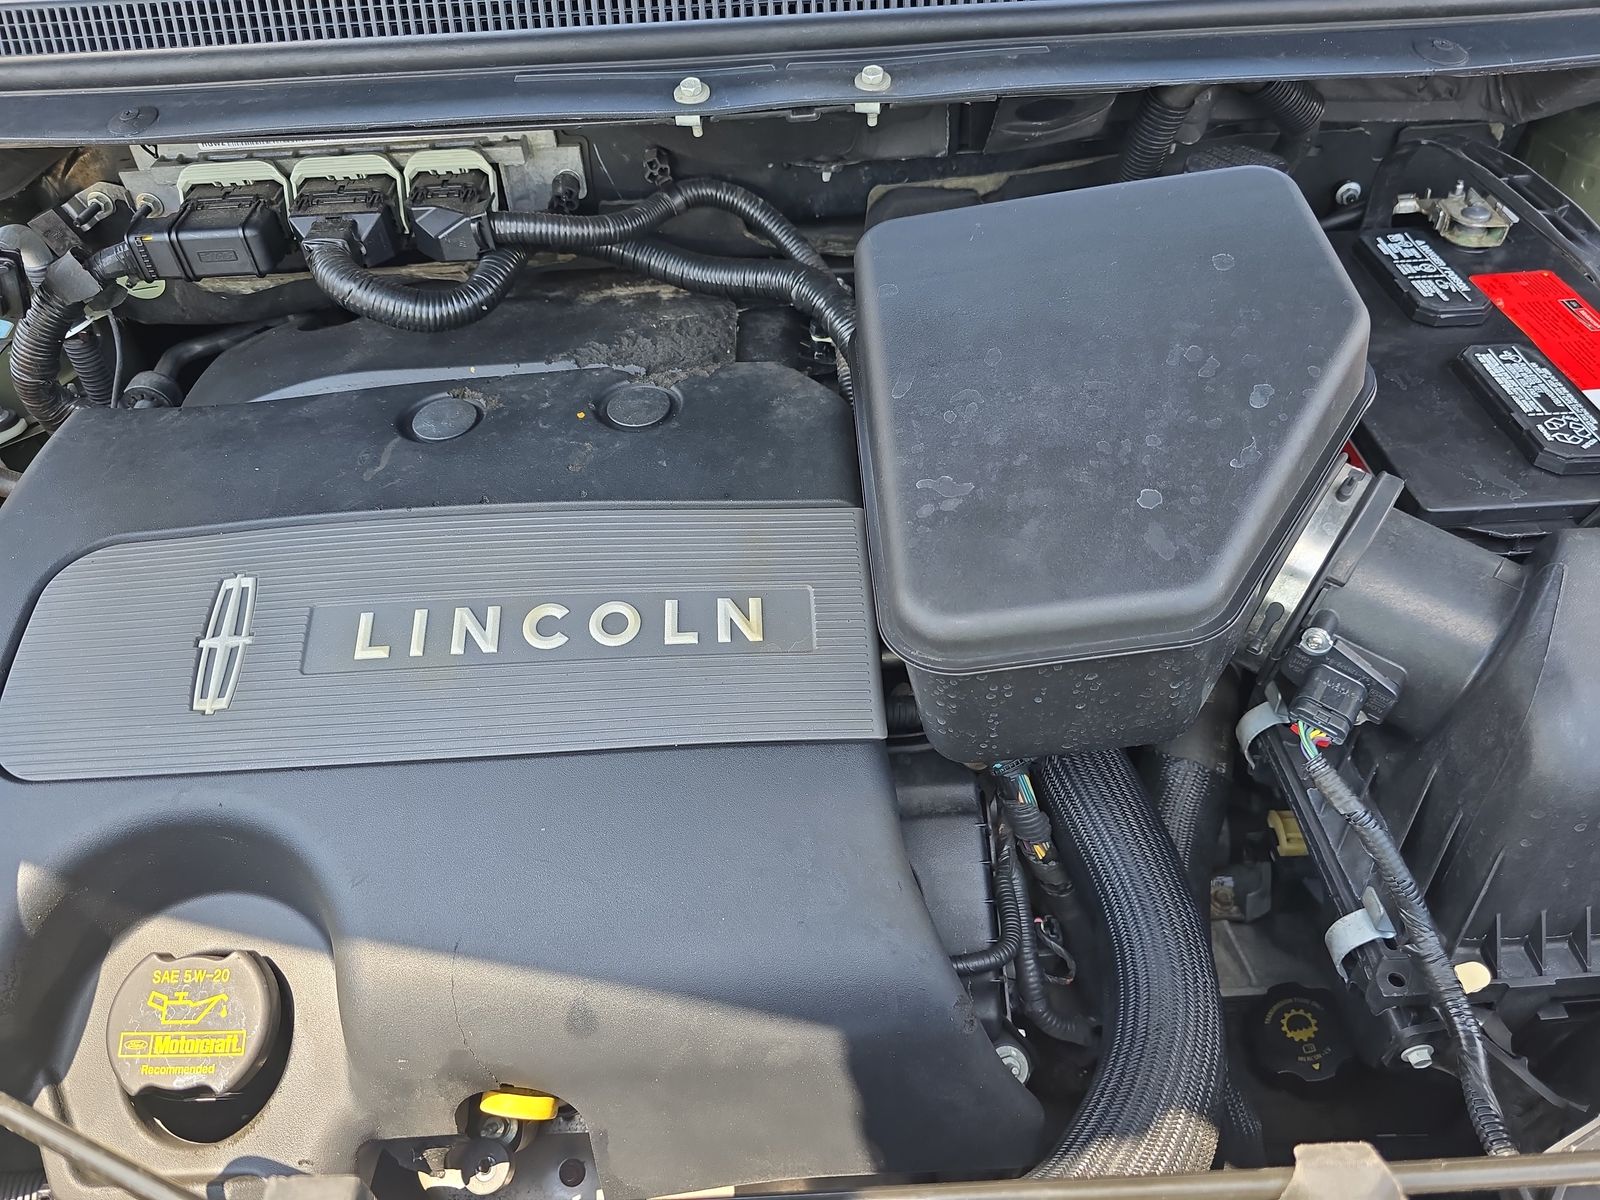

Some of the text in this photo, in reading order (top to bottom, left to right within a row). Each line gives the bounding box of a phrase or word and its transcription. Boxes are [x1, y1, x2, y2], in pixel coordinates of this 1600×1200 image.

[353, 597, 764, 660] LINCOLN
[152, 968, 231, 984] SAE 5W-20
[153, 1034, 241, 1054] Motorcraft
[141, 1063, 216, 1076] Recommended
